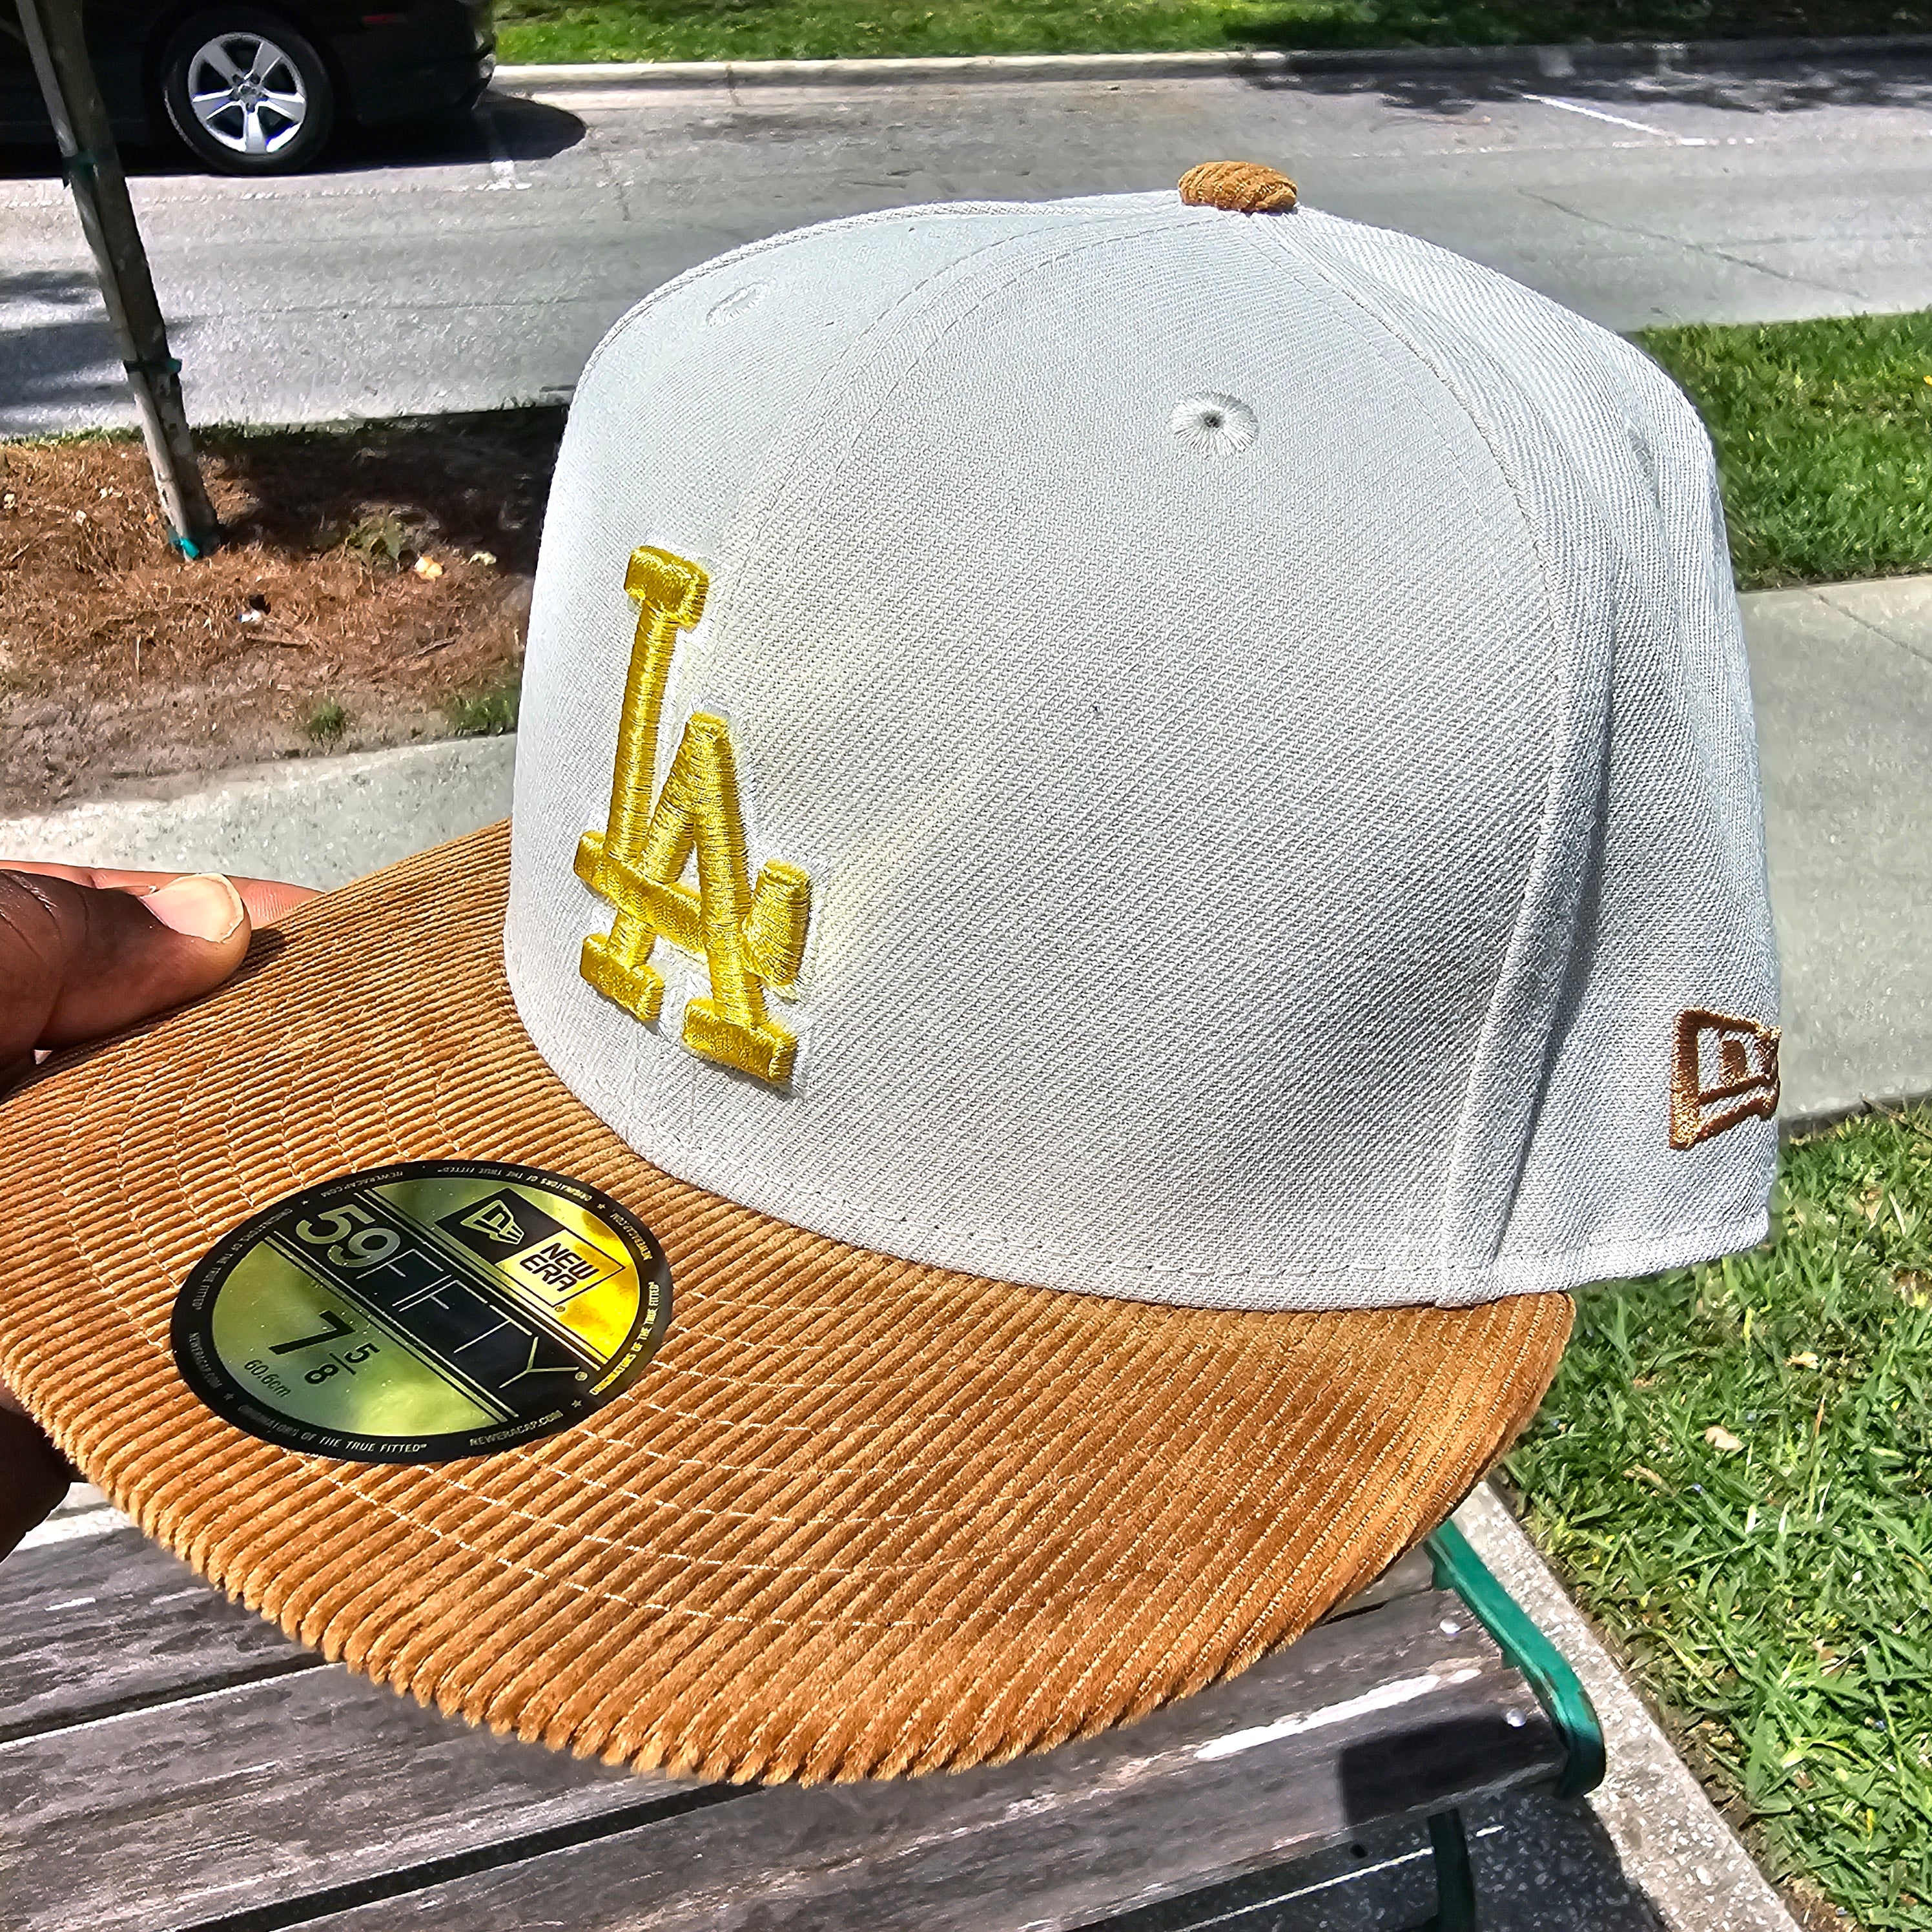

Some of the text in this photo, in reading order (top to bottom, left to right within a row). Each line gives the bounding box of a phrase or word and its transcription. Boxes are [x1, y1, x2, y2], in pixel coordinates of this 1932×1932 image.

[573, 545, 812, 1083] LA
[519, 1253, 578, 1293] ERA
[539, 1242, 601, 1280] NEW
[268, 1310, 356, 1355] 7
[243, 1359, 292, 1398] 60.6cm
[300, 1431, 317, 1441] OF
[318, 1435, 343, 1448] THE
[345, 1440, 375, 1452] TRUE
[469, 1409, 564, 1447] NEWERACAP.COM
